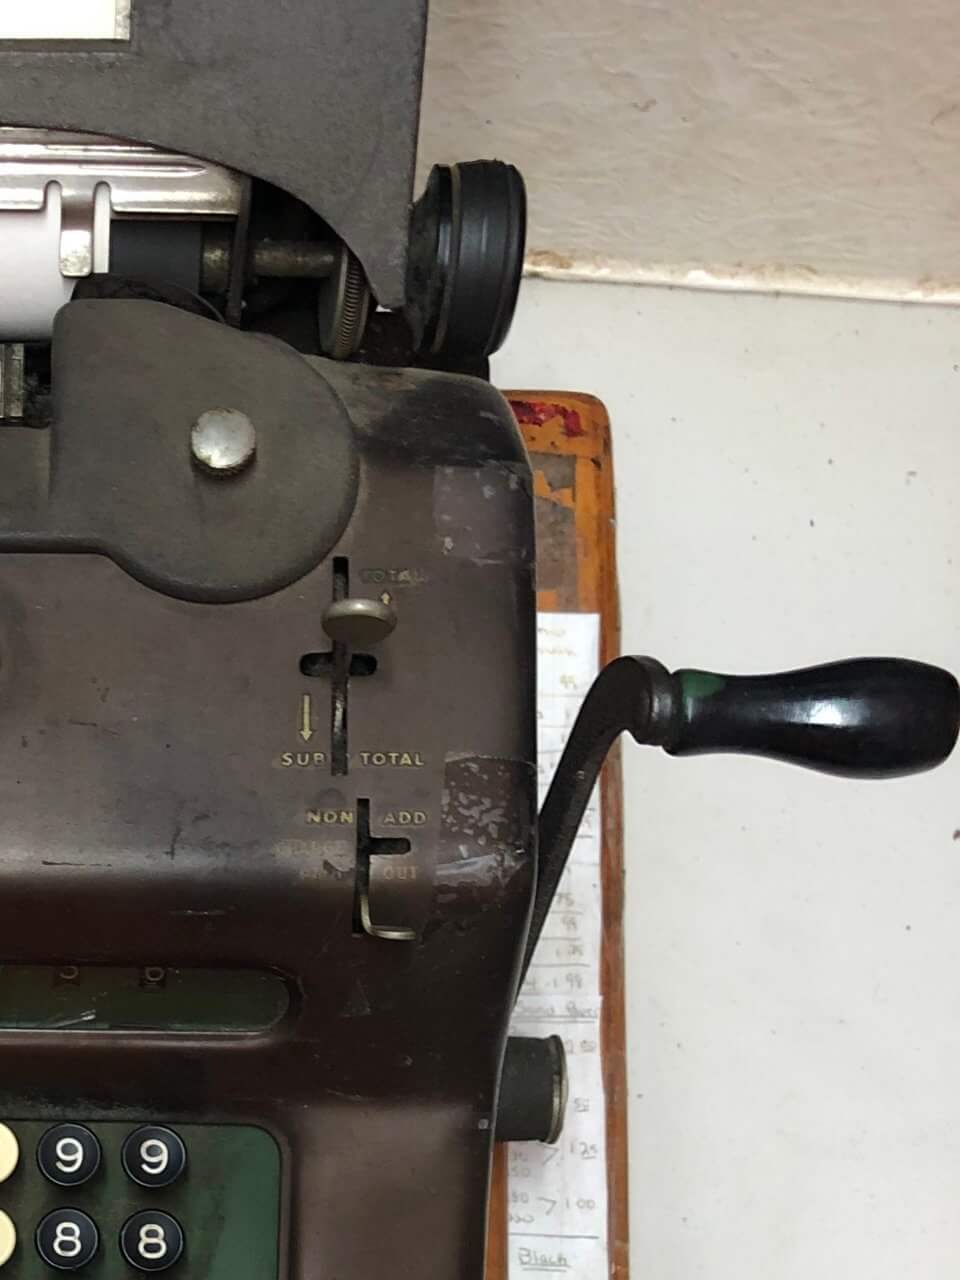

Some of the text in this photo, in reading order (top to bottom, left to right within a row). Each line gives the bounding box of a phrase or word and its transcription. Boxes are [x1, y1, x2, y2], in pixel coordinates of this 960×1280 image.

[281, 752, 424, 767] SUB TOTAL
[306, 810, 428, 825] NON ADD
[56, 1138, 83, 1172] 9
[141, 1139, 168, 1174] 9
[54, 1222, 81, 1256] 8
[139, 1224, 166, 1258] 8
